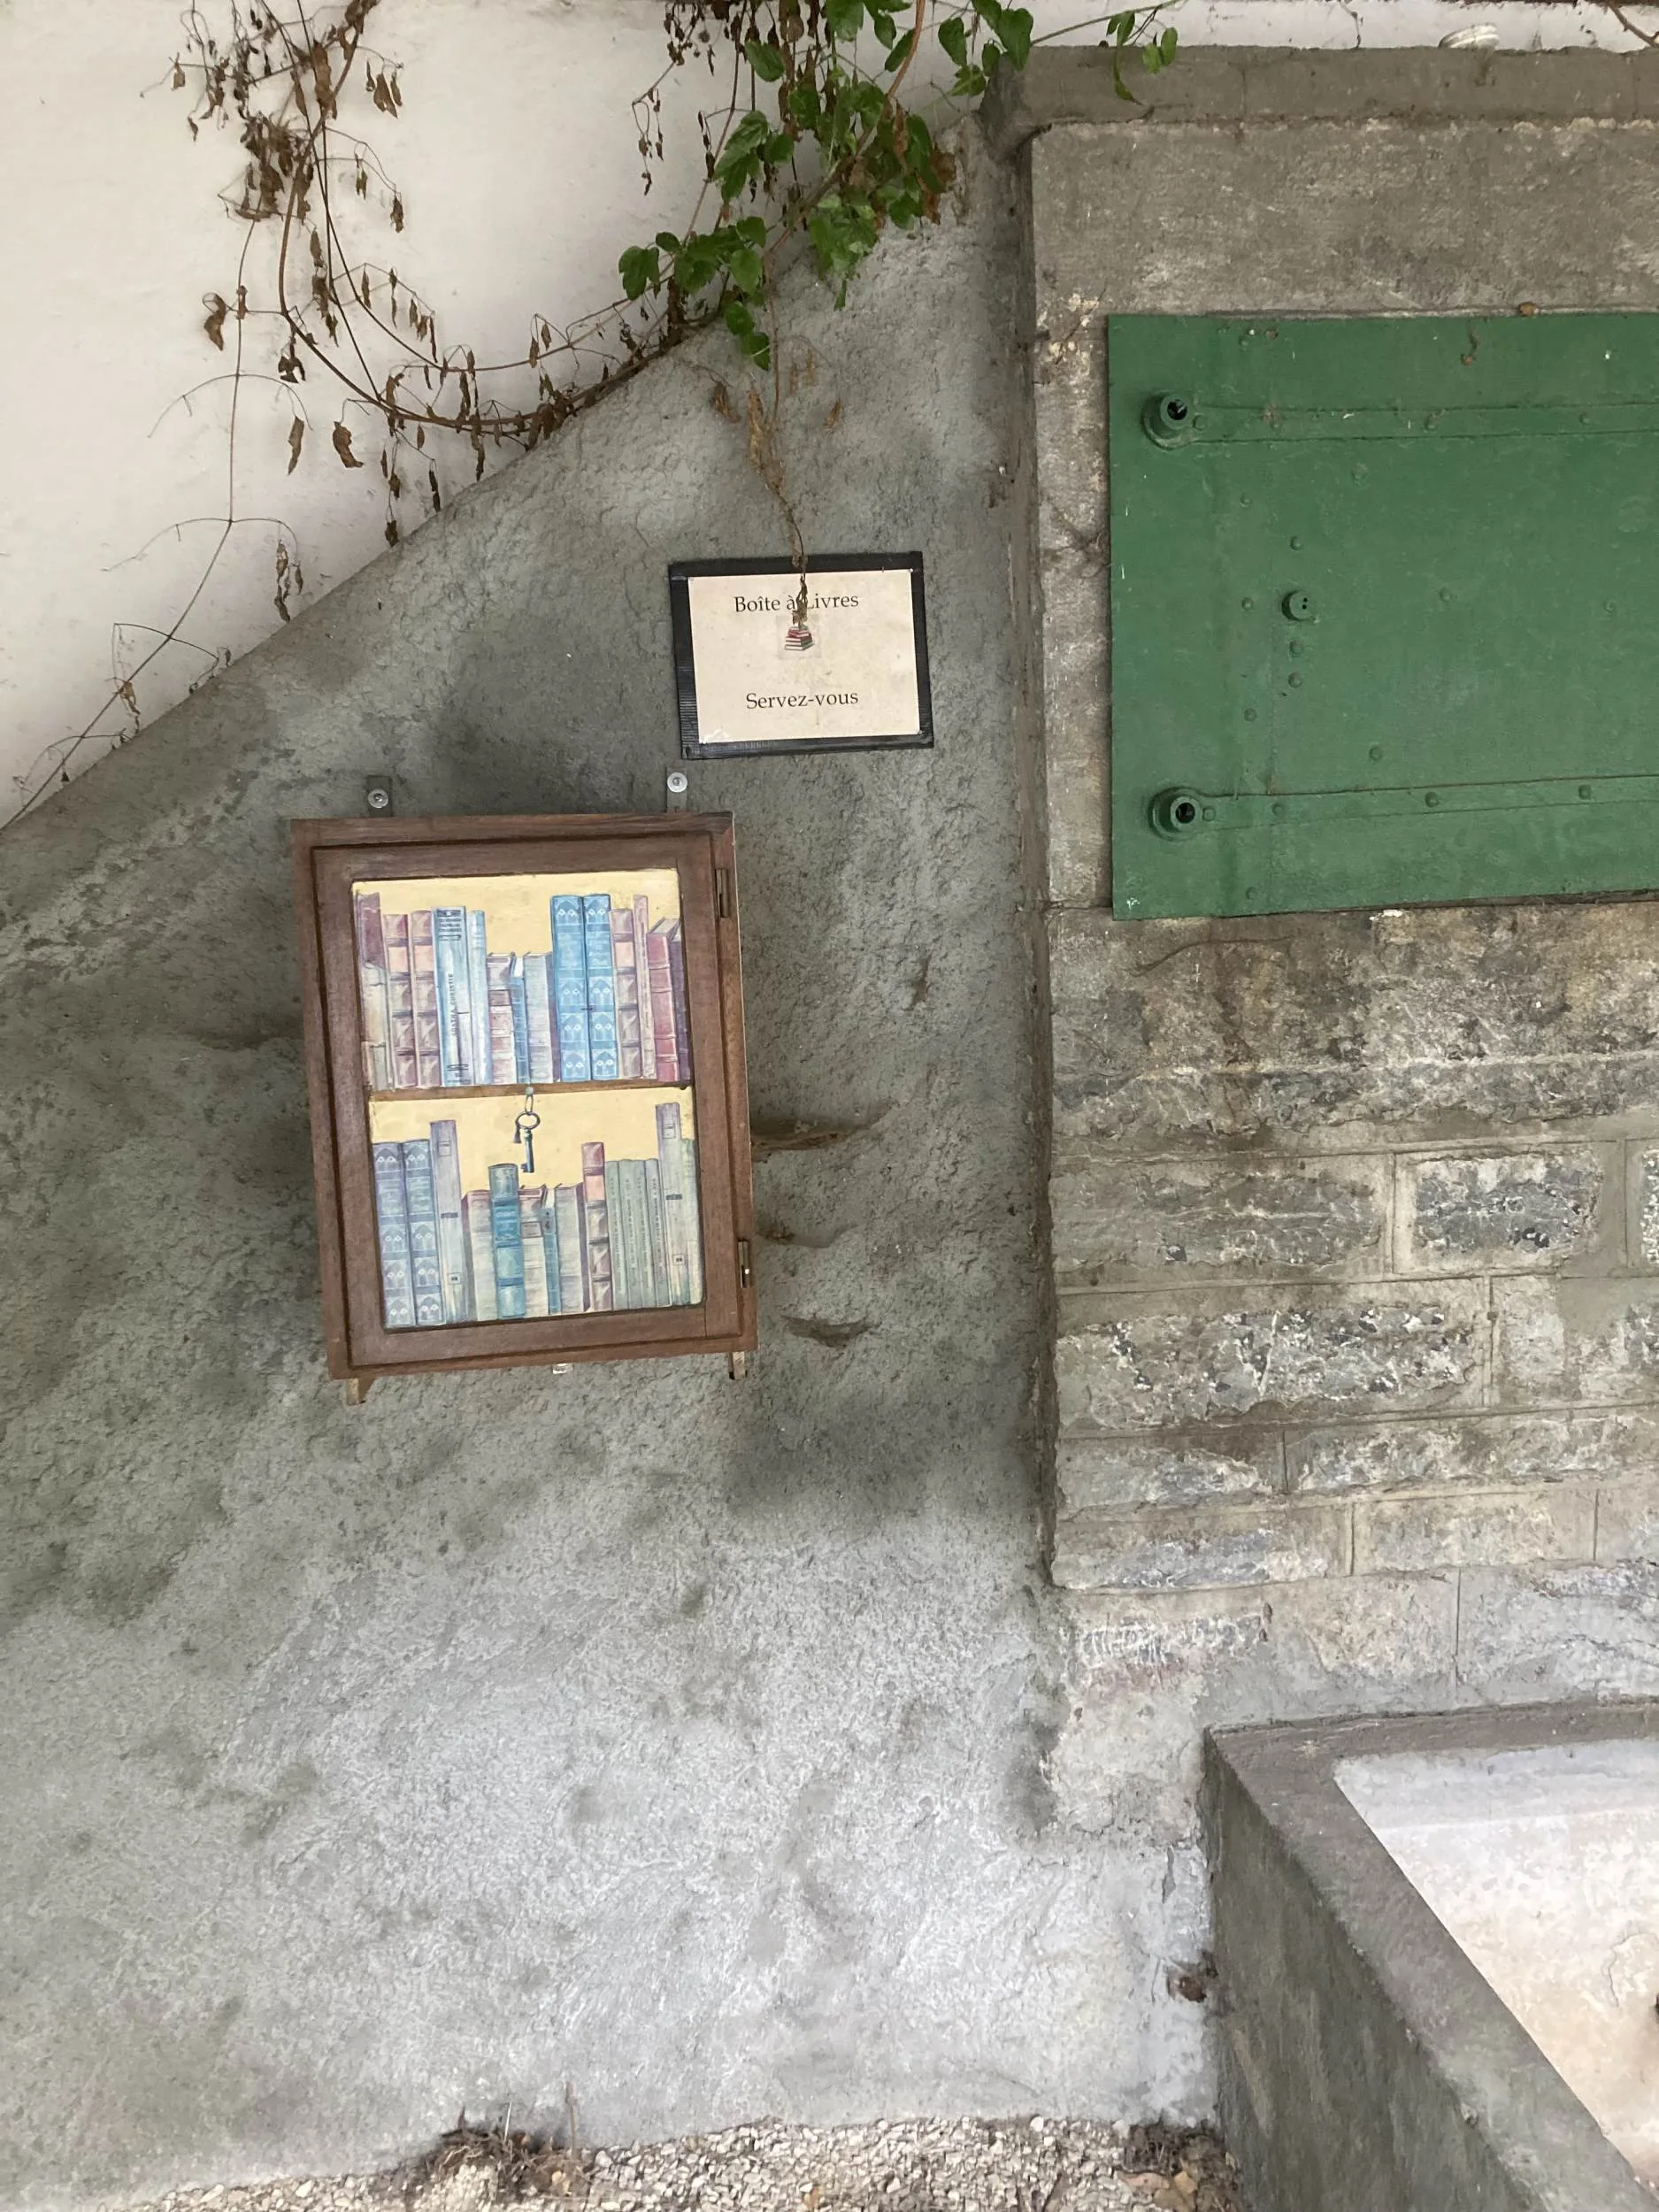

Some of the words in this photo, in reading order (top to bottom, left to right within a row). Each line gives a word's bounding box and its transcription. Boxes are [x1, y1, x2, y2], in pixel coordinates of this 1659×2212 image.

[733, 595, 780, 612] Boîte
[787, 595, 795, 611] à
[746, 692, 859, 710] Servez-vous
